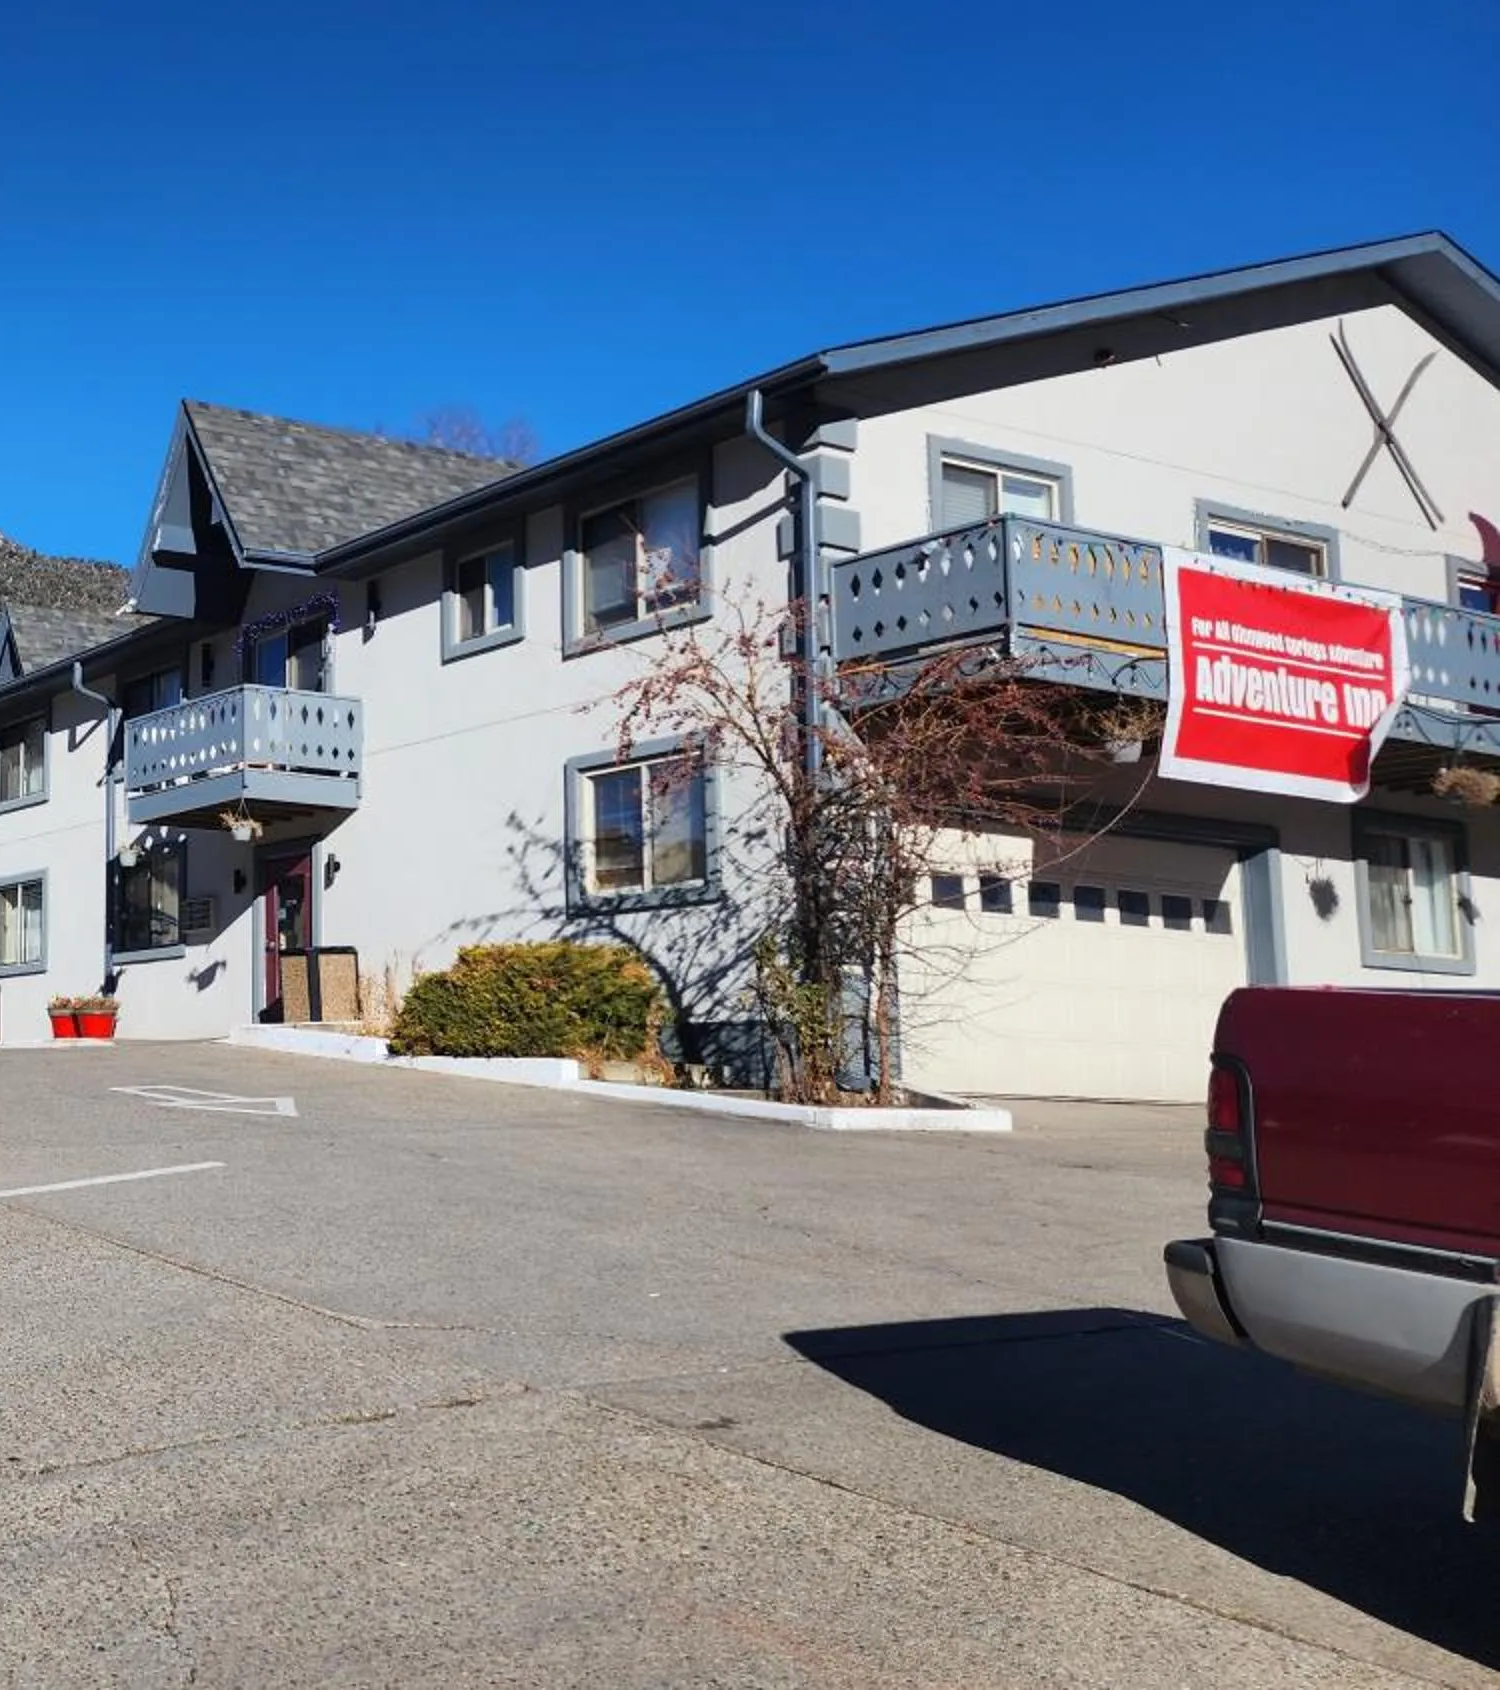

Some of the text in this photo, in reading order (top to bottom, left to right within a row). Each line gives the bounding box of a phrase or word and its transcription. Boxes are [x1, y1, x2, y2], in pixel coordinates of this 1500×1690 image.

[1191, 616, 1213, 638] For
[1215, 619, 1230, 641] All
[1196, 655, 1338, 724] Adventure
